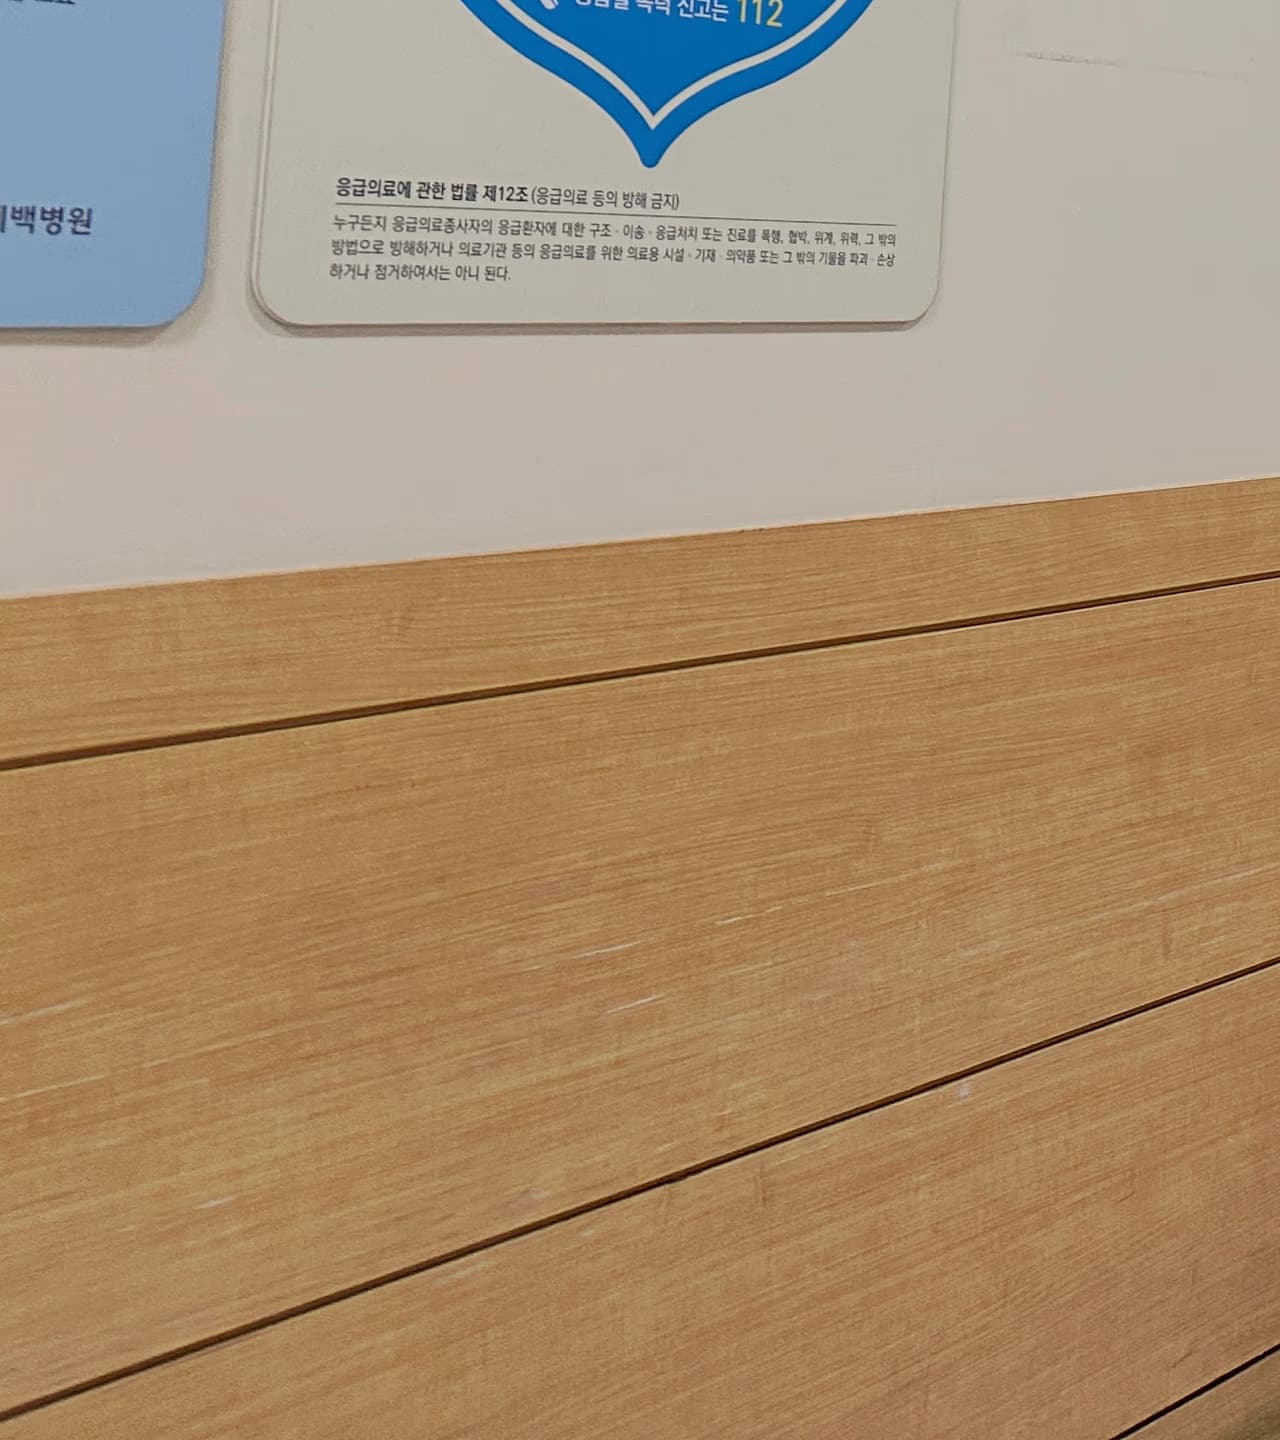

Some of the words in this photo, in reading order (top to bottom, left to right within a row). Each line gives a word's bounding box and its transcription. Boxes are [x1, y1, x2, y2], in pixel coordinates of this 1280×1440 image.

[336, 177, 411, 199] 응급의료에
[415, 181, 445, 201] 관한
[450, 182, 477, 202] 법률
[592, 190, 617, 208] 등의
[622, 191, 647, 209] 방해
[650, 193, 680, 211] 금지)
[333, 214, 387, 233] 누구든지
[392, 216, 493, 236] 응급의료종사자의
[497, 219, 556, 237] 응급환자에
[562, 222, 585, 238] 대한
[702, 227, 722, 242] 또는
[727, 228, 757, 243] 진료를
[864, 233, 875, 247] 그
[878, 232, 896, 248] 밖의
[332, 239, 384, 256] 방법으로
[390, 241, 453, 258] 방해하거나
[459, 242, 507, 259] 의료기관
[511, 243, 535, 260] 등의
[539, 244, 596, 261] 응급의료를
[600, 245, 623, 262] 위한
[627, 246, 659, 262] 의료용
[760, 250, 778, 265] 또는
[783, 251, 793, 264] 그
[329, 263, 370, 280] 하거나
[374, 264, 450, 281] 점거하여서는
[455, 265, 480, 282] 아니
[484, 266, 511, 282] 된다.
